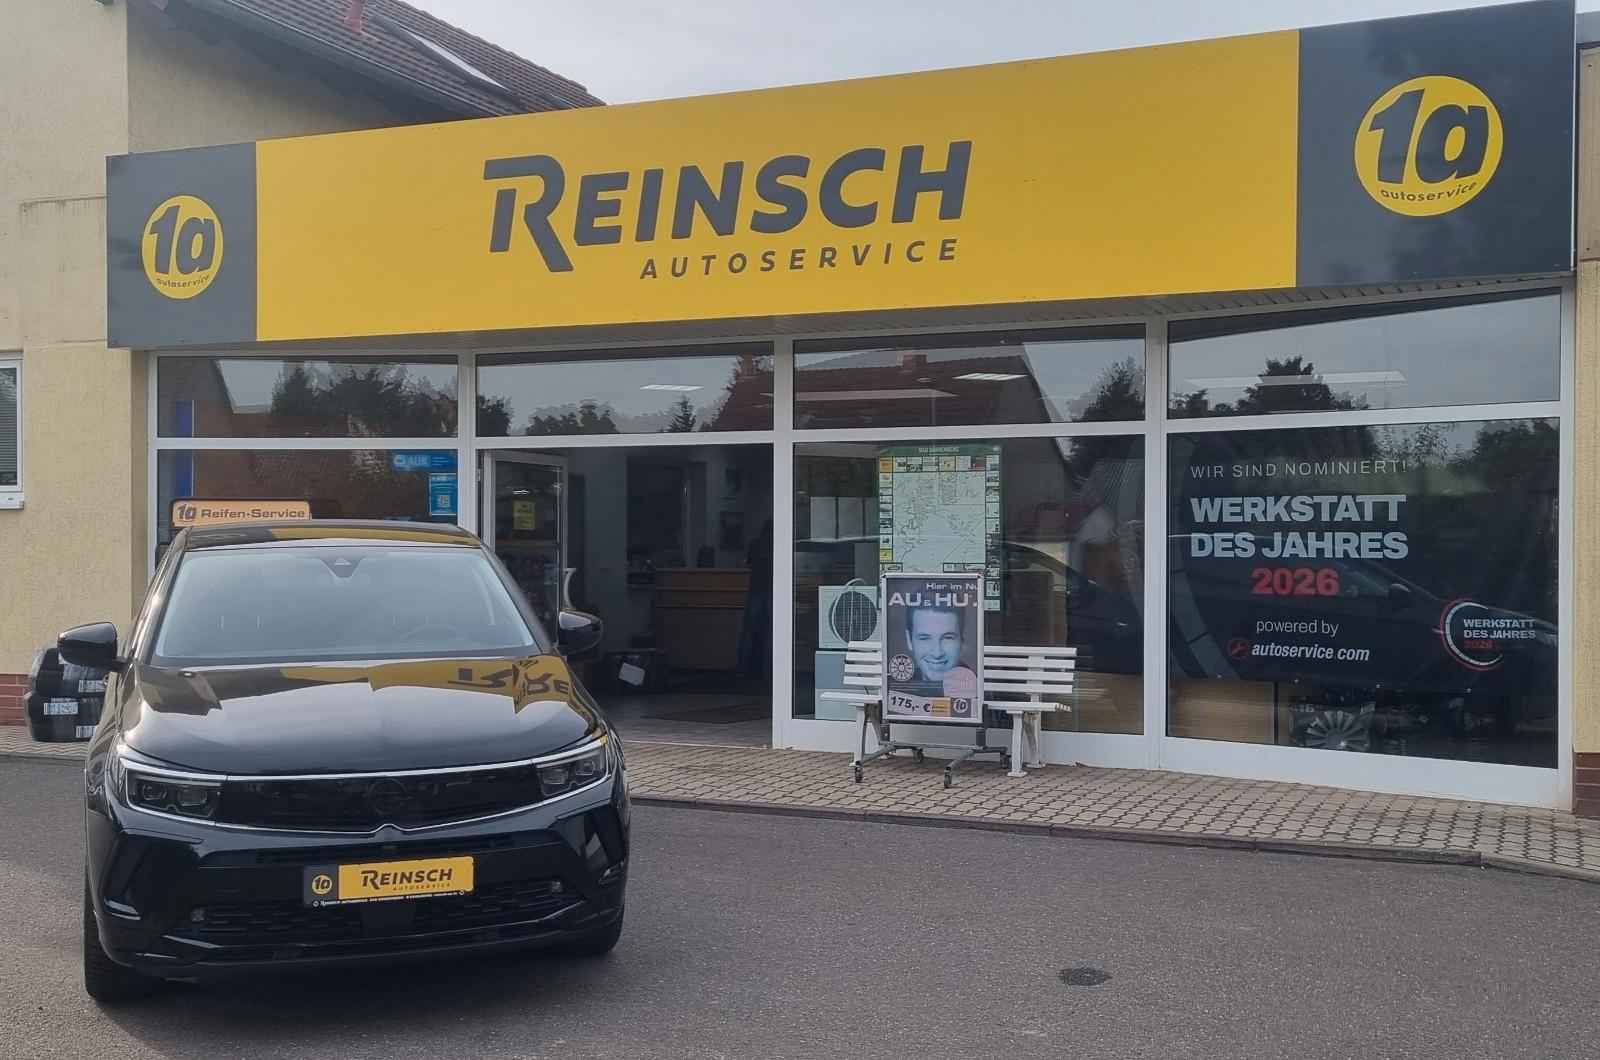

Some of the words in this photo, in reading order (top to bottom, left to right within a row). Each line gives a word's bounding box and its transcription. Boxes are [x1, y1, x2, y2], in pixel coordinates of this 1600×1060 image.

[1368, 88, 1490, 184] 1a
[1380, 181, 1477, 201] autoservice
[483, 140, 972, 272] REINSCH
[149, 205, 216, 274] 1a
[639, 238, 958, 279] AUTOSERVICE
[156, 275, 210, 288] autoservice
[1190, 465, 1224, 478] WIR
[1232, 464, 1276, 478] SIND
[1285, 460, 1407, 476] NOMINIERT!
[1190, 494, 1407, 523] WERKSTATT
[1191, 531, 1255, 558] DES
[1262, 531, 1409, 559] JAHRES
[1252, 567, 1340, 596] 2026
[888, 592, 921, 607] AU
[1256, 620, 1317, 634] powered
[1321, 620, 1339, 637] by
[1463, 619, 1536, 628] WERKSTATT
[1463, 630, 1488, 639] DES
[1490, 630, 1536, 639] JAHRES
[923, 703, 931, 713] €
[361, 868, 453, 890] REINSCH
